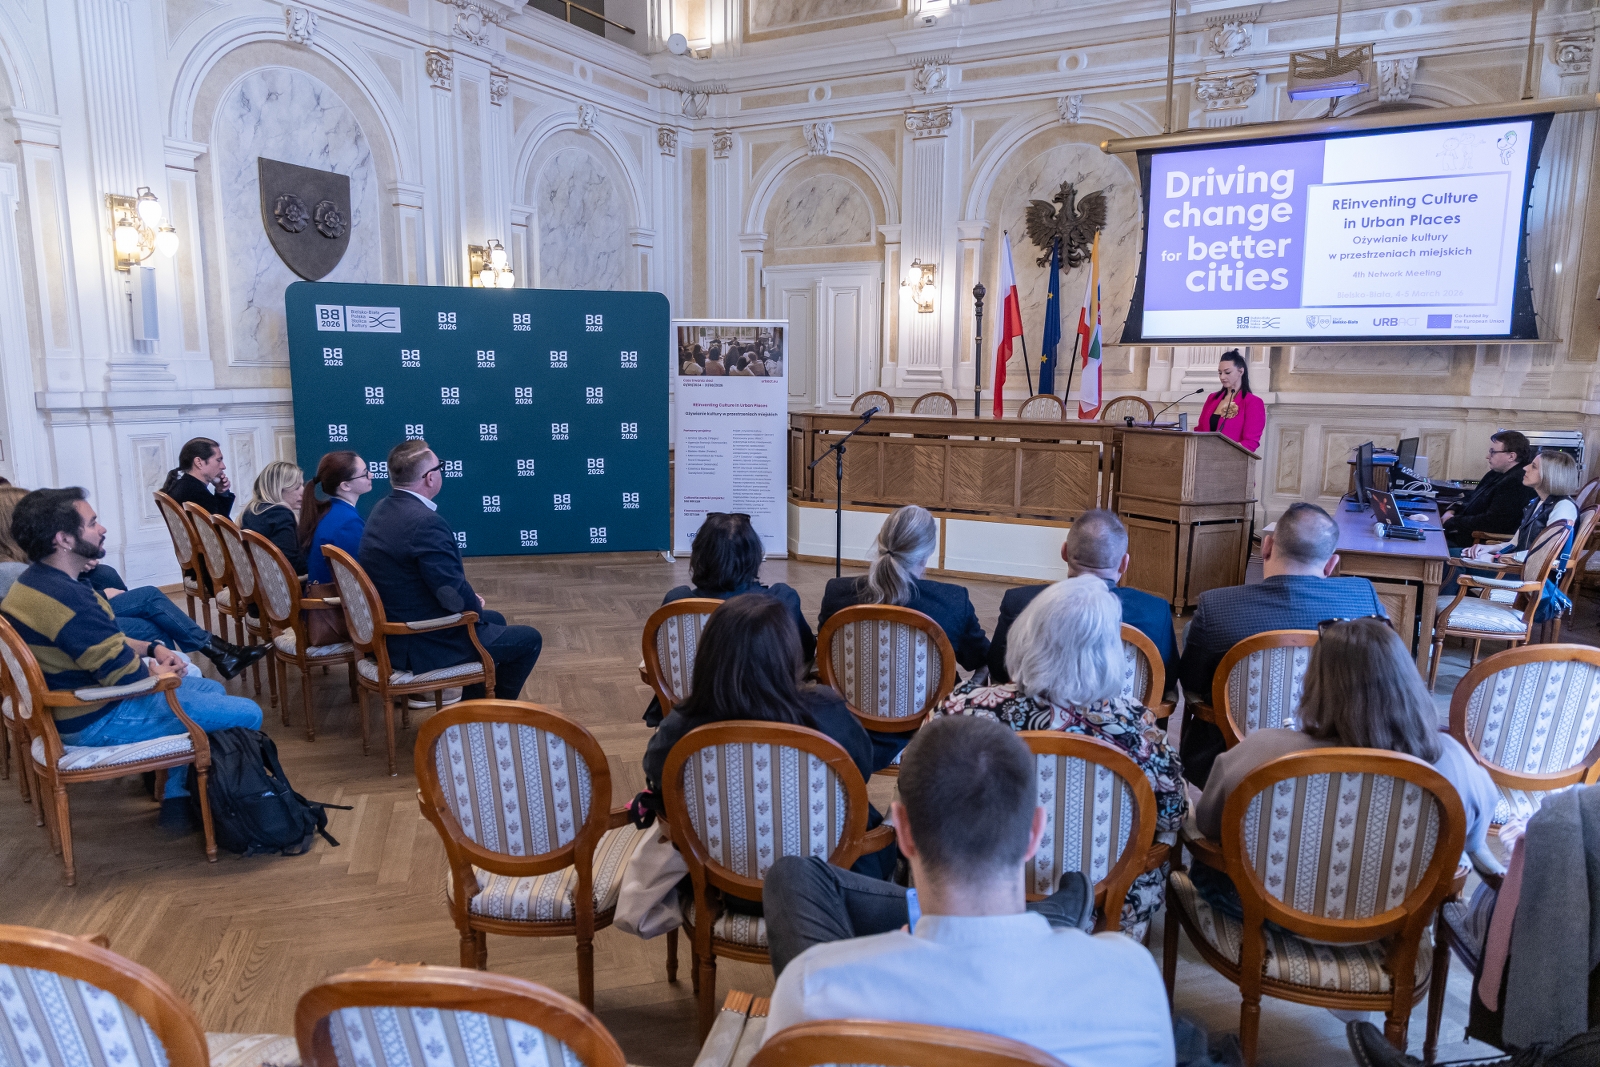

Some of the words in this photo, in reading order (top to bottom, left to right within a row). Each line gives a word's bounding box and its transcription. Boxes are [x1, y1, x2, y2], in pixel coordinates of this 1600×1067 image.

[1166, 164, 1295, 200] Driving
[1332, 195, 1417, 211] REinventing
[1421, 192, 1479, 205] Culture
[1163, 201, 1293, 232] change
[1344, 218, 1356, 229] in
[1361, 216, 1405, 228] Urban
[1410, 214, 1461, 226] Places
[1352, 234, 1408, 245] Ożywianie
[1411, 232, 1449, 243] kultury
[1160, 250, 1182, 262] for
[1187, 235, 1292, 261] better
[1339, 248, 1416, 261] przestrzeniach
[1419, 246, 1472, 258] miejskich
[1185, 260, 1289, 292] cities
[1352, 270, 1366, 279] 4th
[1367, 269, 1403, 278] Network
[1405, 269, 1442, 278] Meeting
[1395, 290, 1410, 298] 4-5
[1411, 289, 1440, 298] March
[1442, 289, 1464, 297] 2026
[321, 320, 341, 328] 2026
[1372, 317, 1420, 327] URBACT
[438, 323, 457, 331] 2026
[513, 324, 531, 332] 2026
[324, 359, 344, 367] 2026
[620, 361, 638, 369] 2026
[365, 397, 385, 405] 2026
[515, 397, 533, 405] 2026
[586, 397, 604, 405] 2026
[551, 433, 569, 441] 2026
[483, 505, 501, 513] 2026
[623, 502, 640, 510] 2026
[521, 539, 538, 547] 2026
[590, 537, 607, 545] 2026
